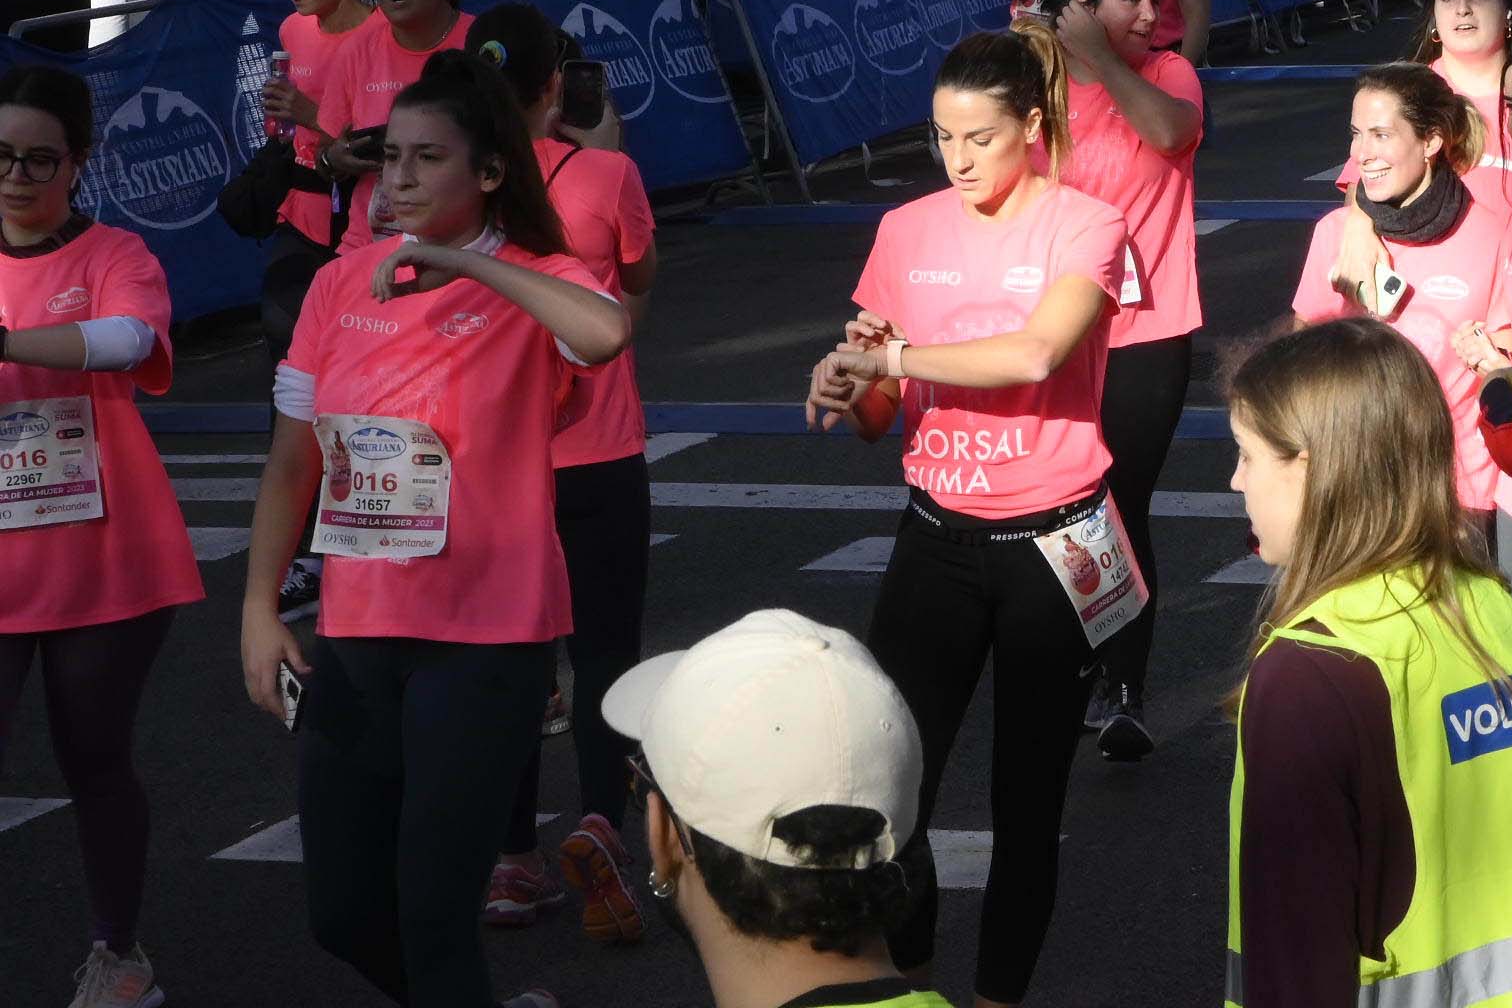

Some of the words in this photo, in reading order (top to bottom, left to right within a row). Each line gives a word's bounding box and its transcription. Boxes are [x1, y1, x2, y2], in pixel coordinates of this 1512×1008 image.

[112, 141, 225, 202] ASTURIANA
[340, 313, 398, 335] OYSHO
[351, 439, 402, 452] ASTURIANA
[0, 449, 48, 470] 016
[6, 473, 43, 487] 22967
[353, 471, 398, 493] 016
[46, 501, 90, 514] Santander
[355, 497, 391, 511] 31657
[357, 517, 368, 526] DE
[369, 517, 380, 526] LA
[382, 518, 412, 527] MUJER
[323, 531, 358, 547] OYSHO
[391, 536, 435, 548] Santander
[1094, 607, 1126, 634] OYSHO
